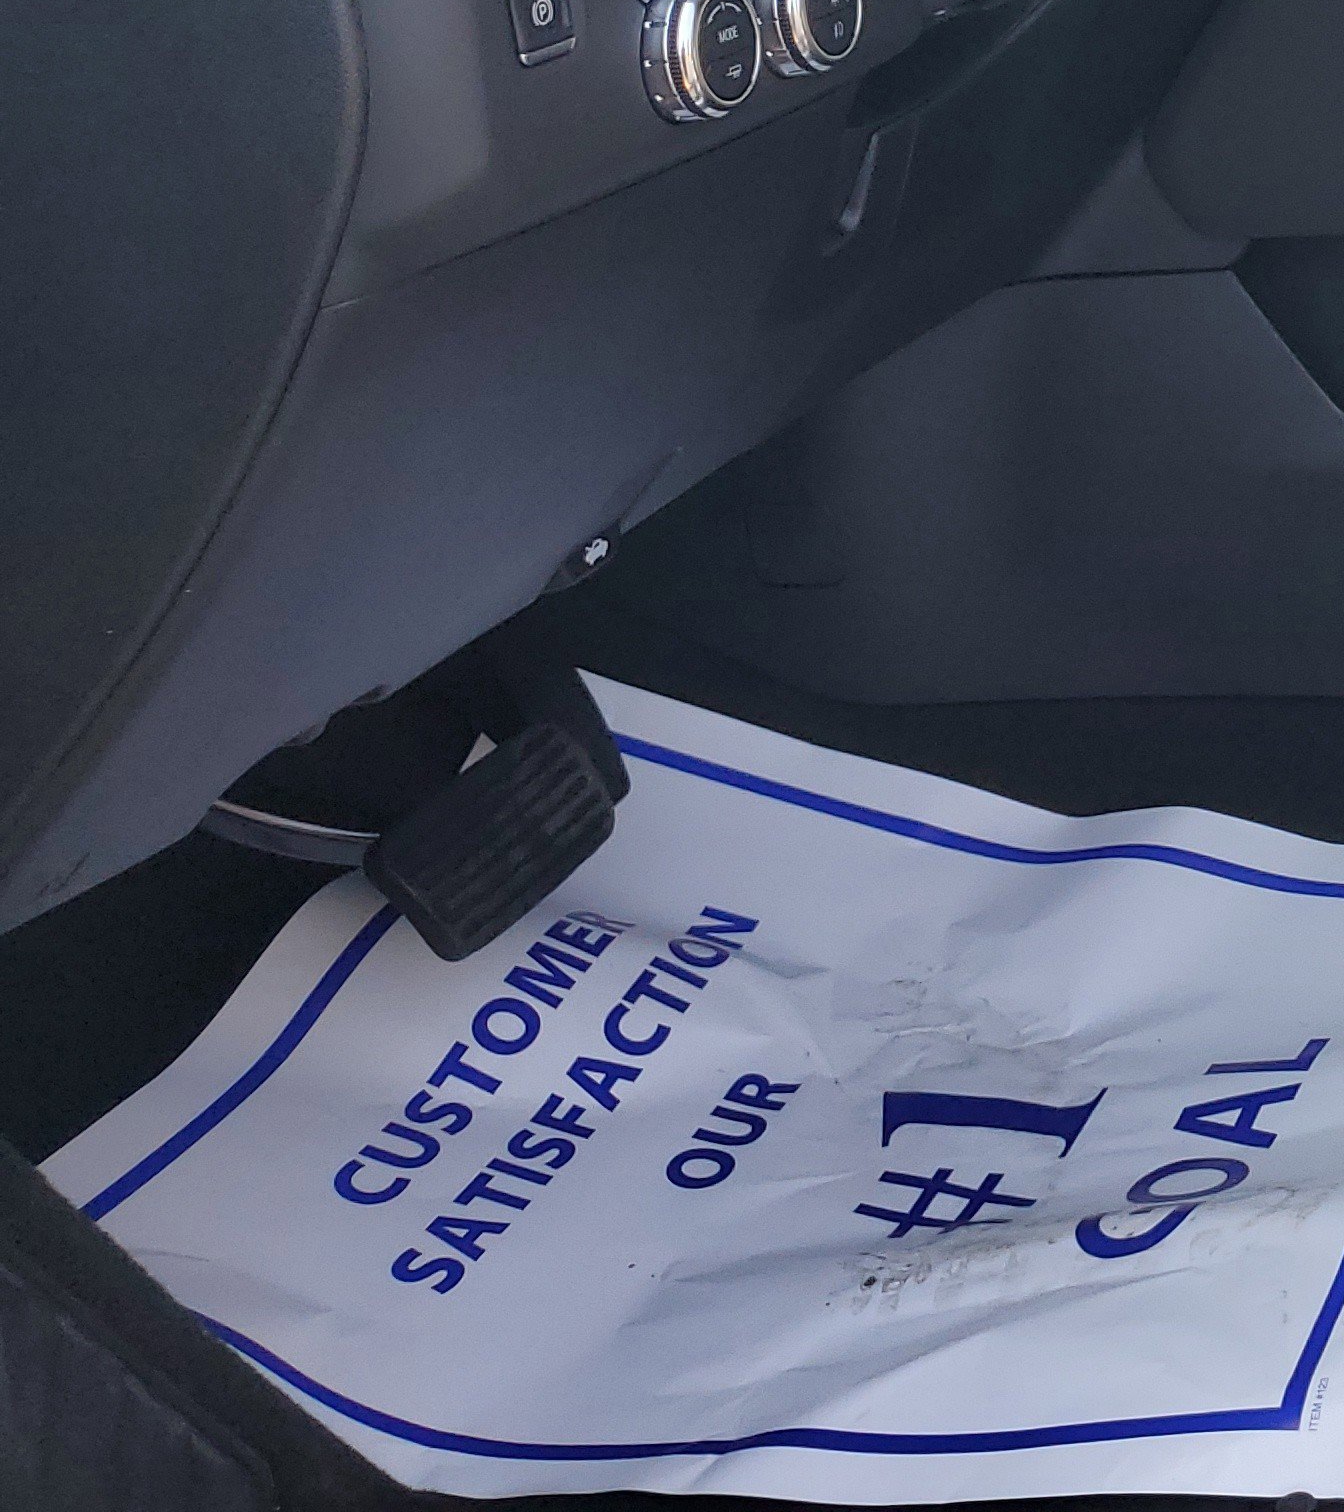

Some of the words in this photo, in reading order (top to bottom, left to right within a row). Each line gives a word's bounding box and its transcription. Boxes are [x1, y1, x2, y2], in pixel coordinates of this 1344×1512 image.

[718, 25, 739, 43] MODE
[333, 910, 636, 1205] CUSTOMER
[391, 905, 760, 1295] SATISFACTION
[665, 1071, 803, 1189] OUR
[853, 1087, 1108, 1239] #1
[1308, 1402, 1322, 1431] ITEM
